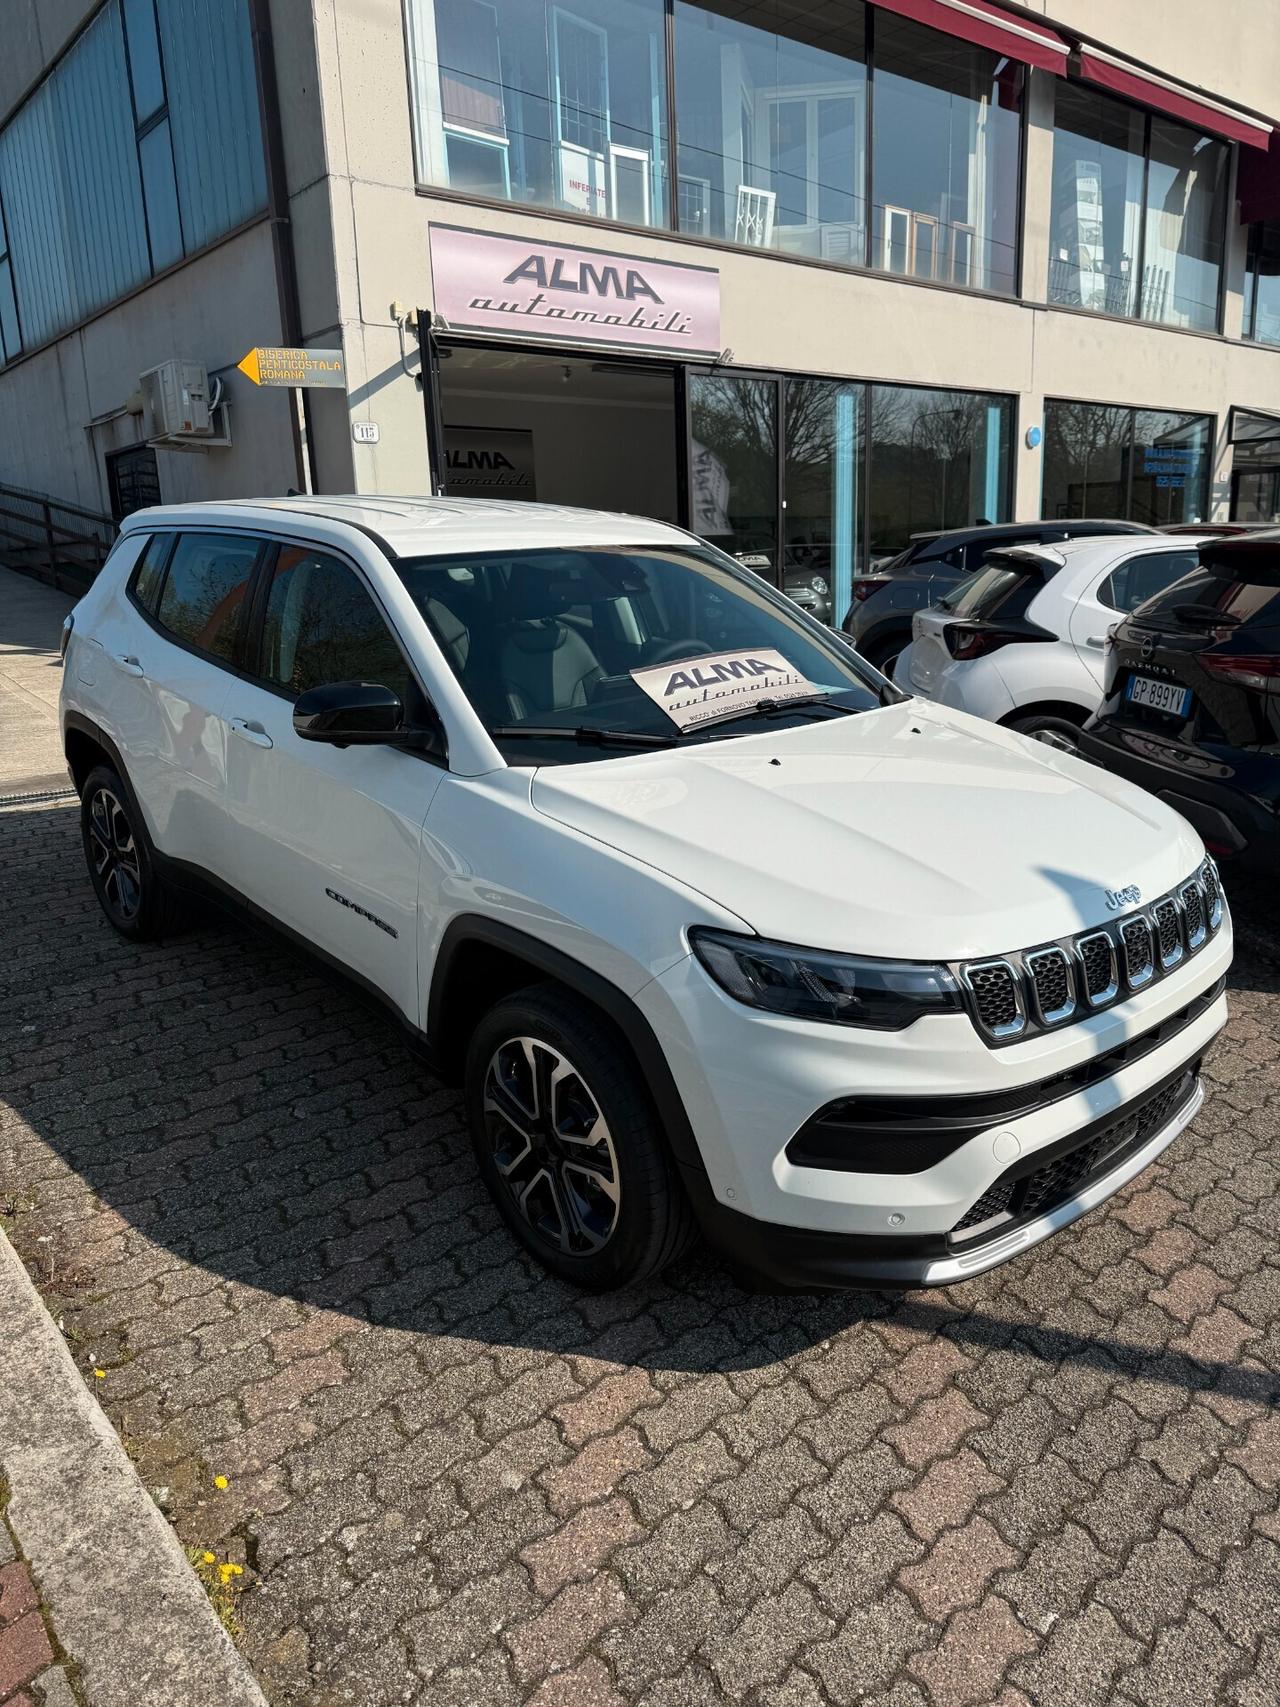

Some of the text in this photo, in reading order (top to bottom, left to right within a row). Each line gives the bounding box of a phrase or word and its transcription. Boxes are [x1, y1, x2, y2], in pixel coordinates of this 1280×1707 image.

[503, 254, 665, 305] ALMA
[469, 293, 692, 334] automobili
[258, 349, 308, 359] BISERICA
[259, 359, 341, 370] PENTICOSTALA
[260, 369, 305, 379] ROMANA
[360, 427, 375, 439] 115
[663, 658, 787, 697] ALMA
[669, 674, 803, 711] automobili
[1133, 679, 1184, 712] GP 899YV
[1105, 884, 1141, 911] Jeep
